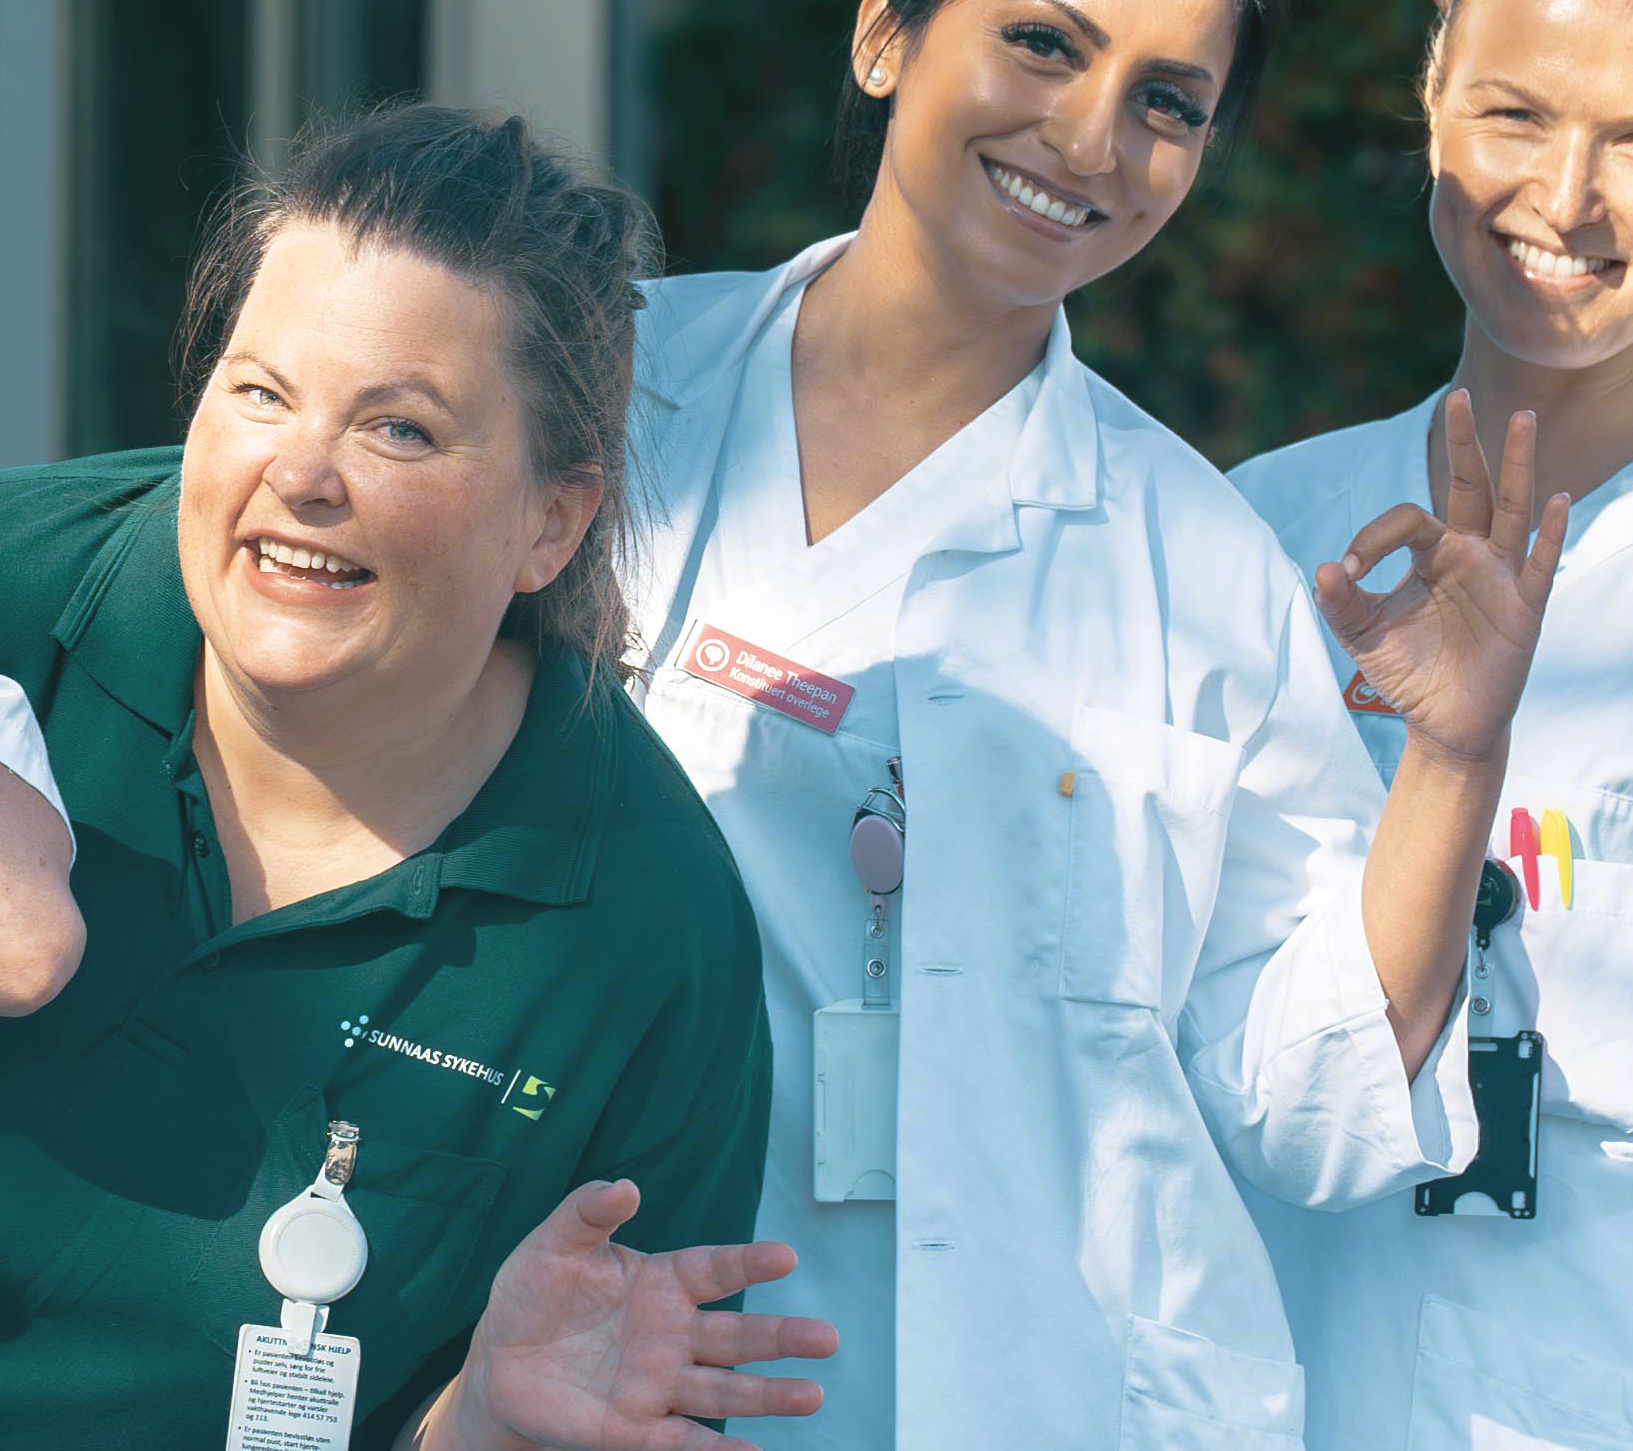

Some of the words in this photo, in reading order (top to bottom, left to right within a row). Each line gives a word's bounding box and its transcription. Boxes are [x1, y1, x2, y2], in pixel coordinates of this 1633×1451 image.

[729, 667, 788, 699] Konstituert
[787, 694, 830, 718] overlege
[736, 650, 784, 681] Dilanee
[785, 670, 837, 705] Theepan
[368, 1029, 442, 1065] SUNNAAS
[442, 1054, 504, 1085] SYKEHUS
[329, 1346, 351, 1355] HJELP
